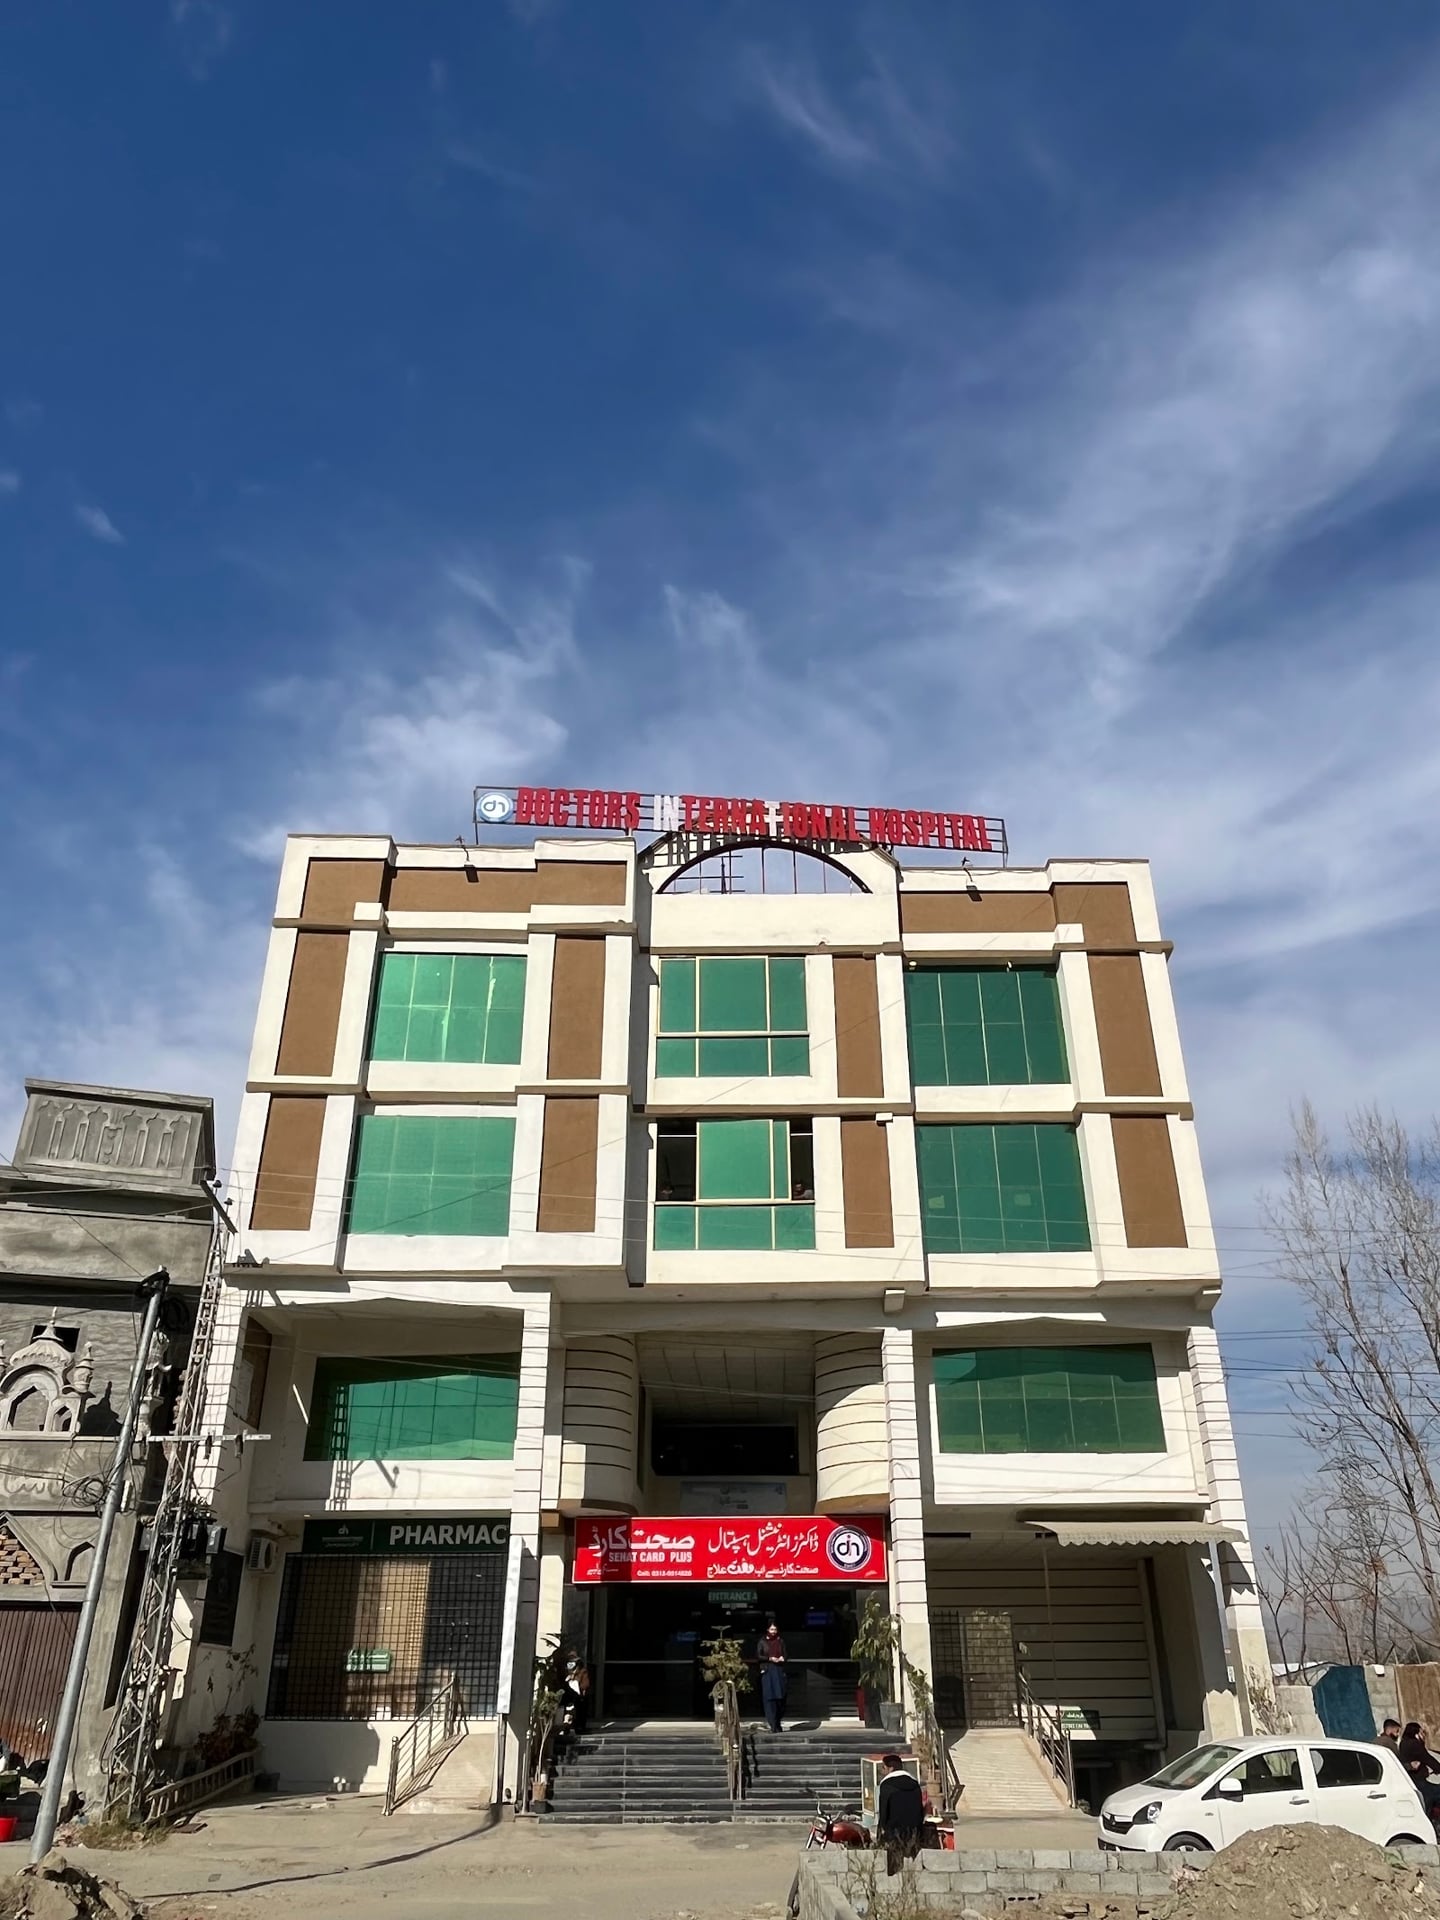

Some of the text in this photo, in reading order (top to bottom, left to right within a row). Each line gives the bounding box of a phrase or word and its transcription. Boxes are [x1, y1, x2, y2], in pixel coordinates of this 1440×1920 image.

[514, 786, 993, 851] DOCTORS INTERNATIONAL HOSPITAL
[389, 1524, 507, 1545] PHARMAC
[587, 1524, 696, 1557] صحت کارڈ
[608, 1551, 693, 1563] SEHAT CARD PLUS
[707, 1591, 751, 1602] ENTRANCE
